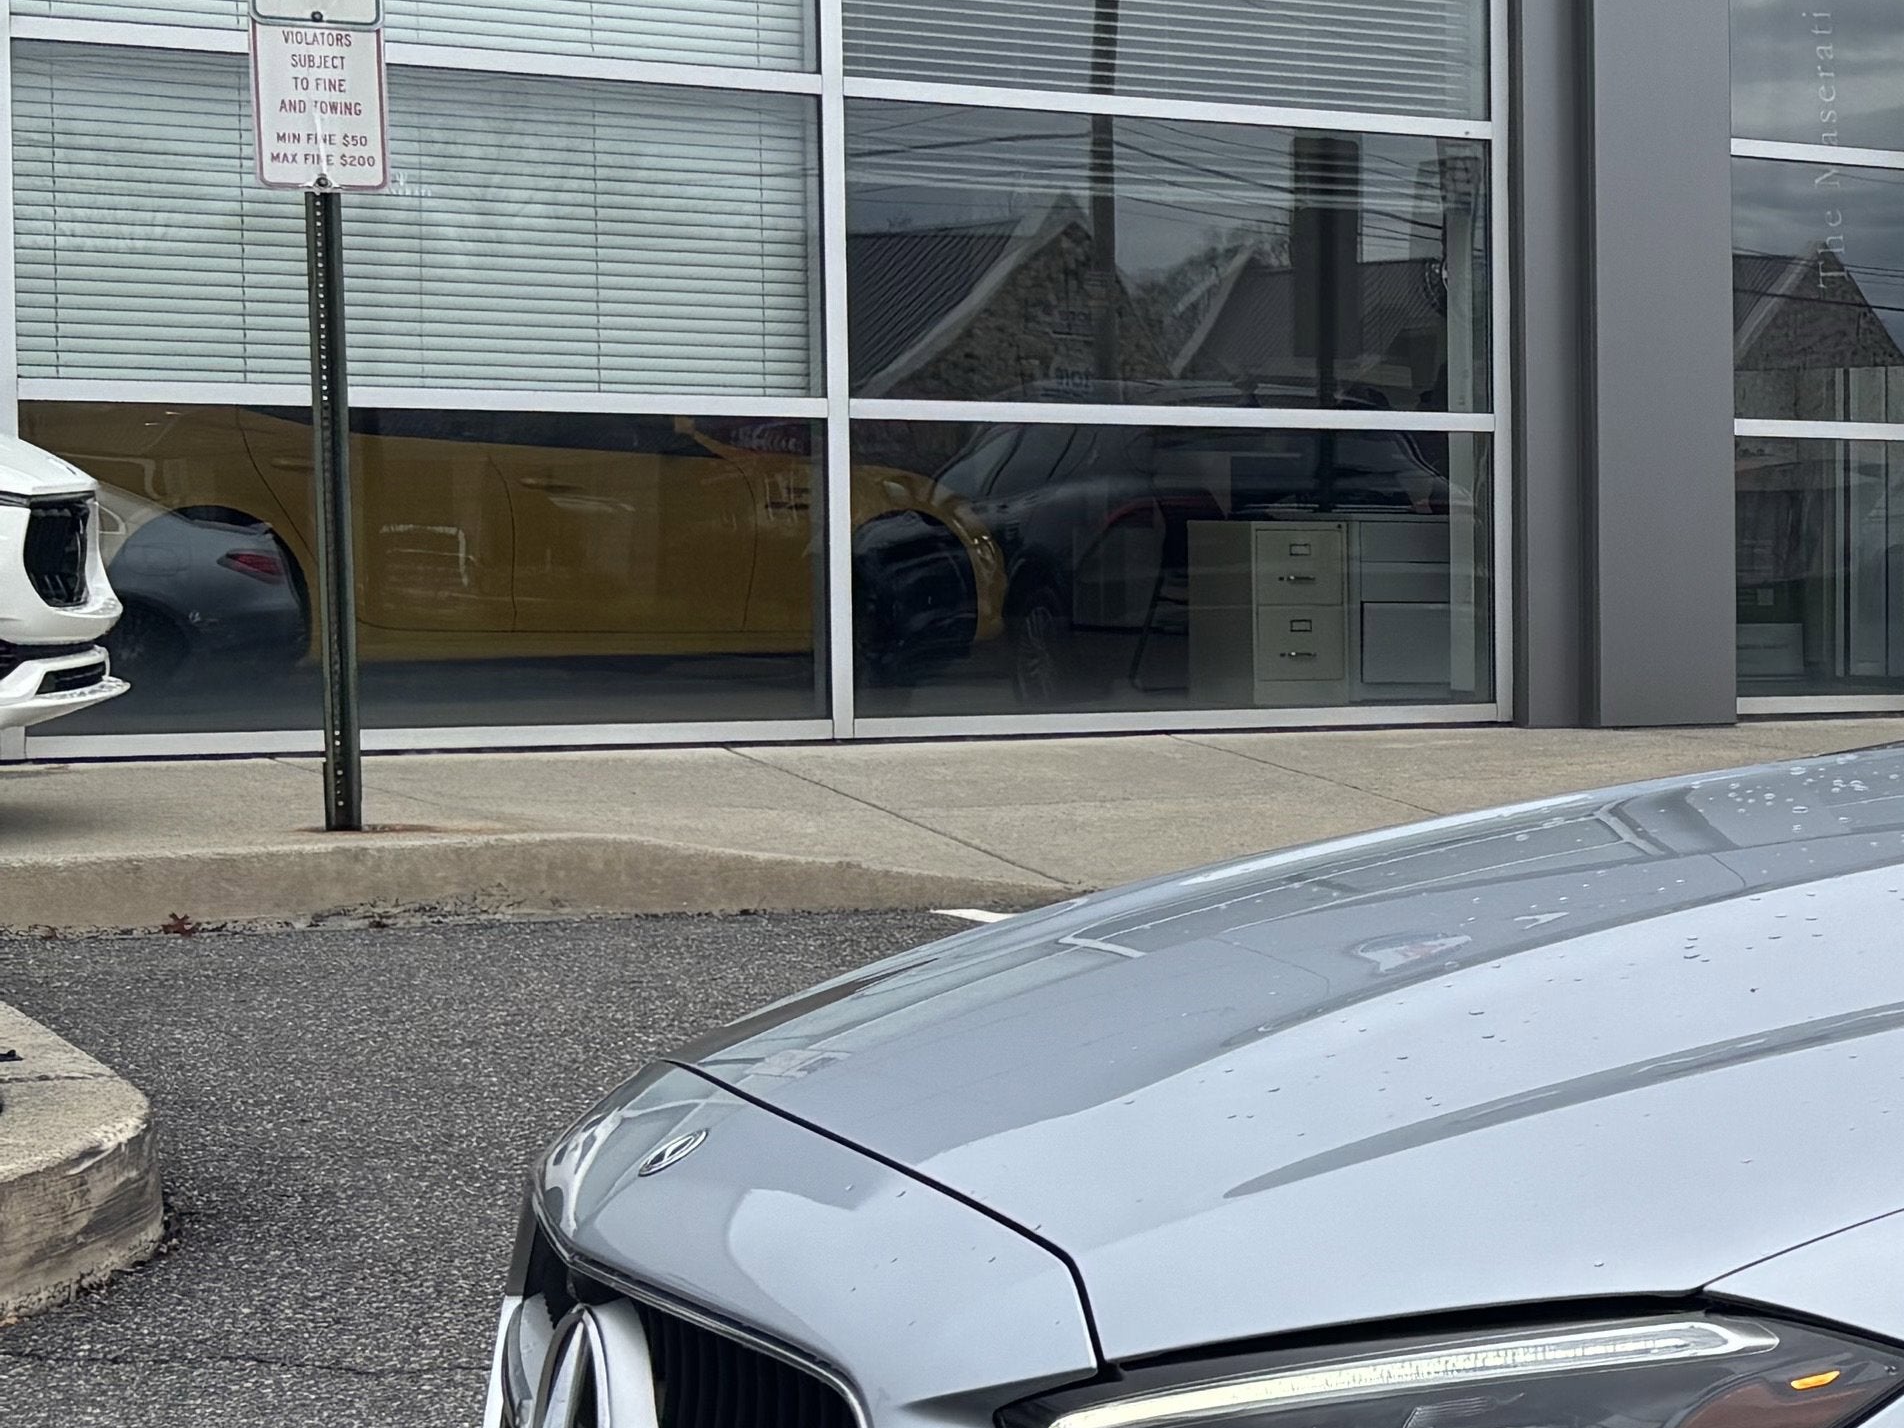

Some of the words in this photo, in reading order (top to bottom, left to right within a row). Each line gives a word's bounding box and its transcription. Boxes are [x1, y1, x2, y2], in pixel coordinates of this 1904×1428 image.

[281, 29, 352, 47] VIOLATORS
[290, 54, 345, 70] SUBJECT
[292, 76, 310, 91] TO
[315, 77, 346, 93] FINE
[279, 99, 306, 113] AND
[276, 132, 300, 144] MIN
[342, 133, 368, 147] $50
[270, 152, 298, 164] MAX
[340, 154, 376, 167] $200
